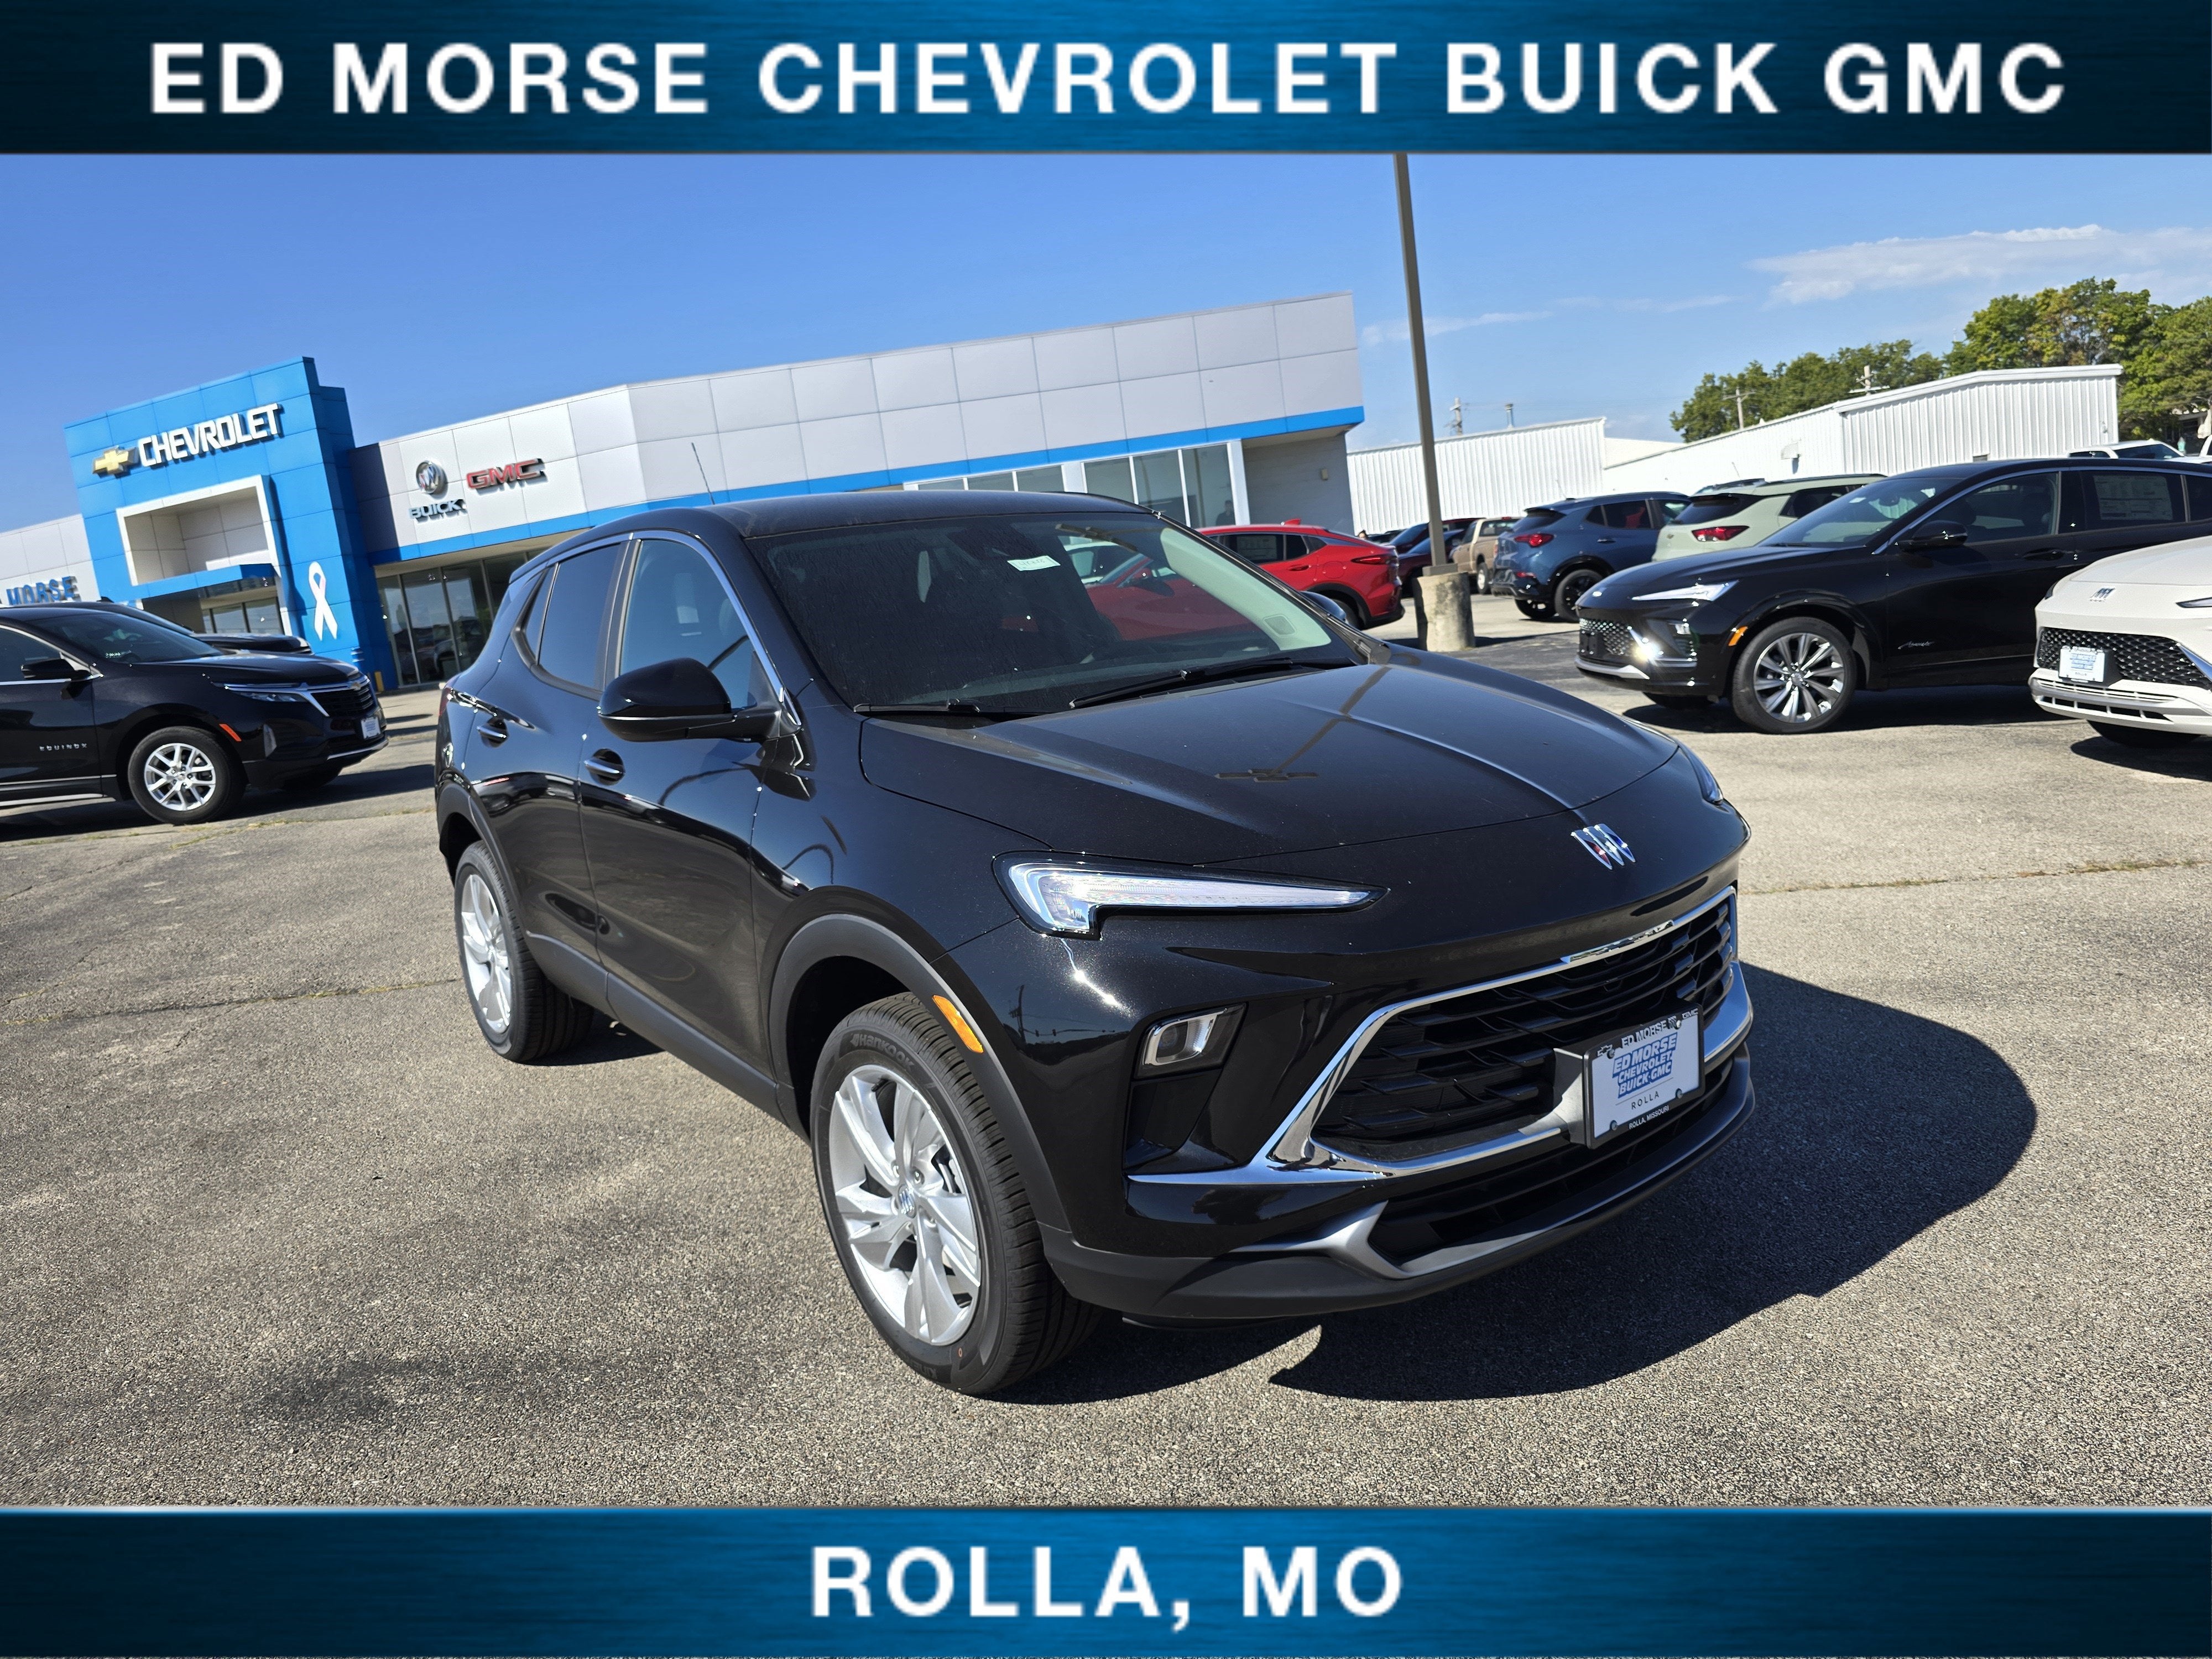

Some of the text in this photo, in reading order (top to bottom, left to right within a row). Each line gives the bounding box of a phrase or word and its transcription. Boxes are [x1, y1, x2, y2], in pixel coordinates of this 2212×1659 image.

[138, 403, 279, 467] CHEVROLET
[466, 458, 544, 489] GMC
[408, 499, 463, 519] BUICK
[6, 576, 78, 606] MORSE
[39, 743, 87, 752] EQUINOX
[1682, 1008, 1699, 1020] GMC
[1621, 1020, 1667, 1048] ED MORSE
[1613, 1033, 1677, 1074] ED MORSE
[1618, 1050, 1672, 1084] CHEVROLET
[1631, 1091, 1660, 1110] ROLLA
[1629, 1105, 1670, 1130] ROLLA, MISSOURI
